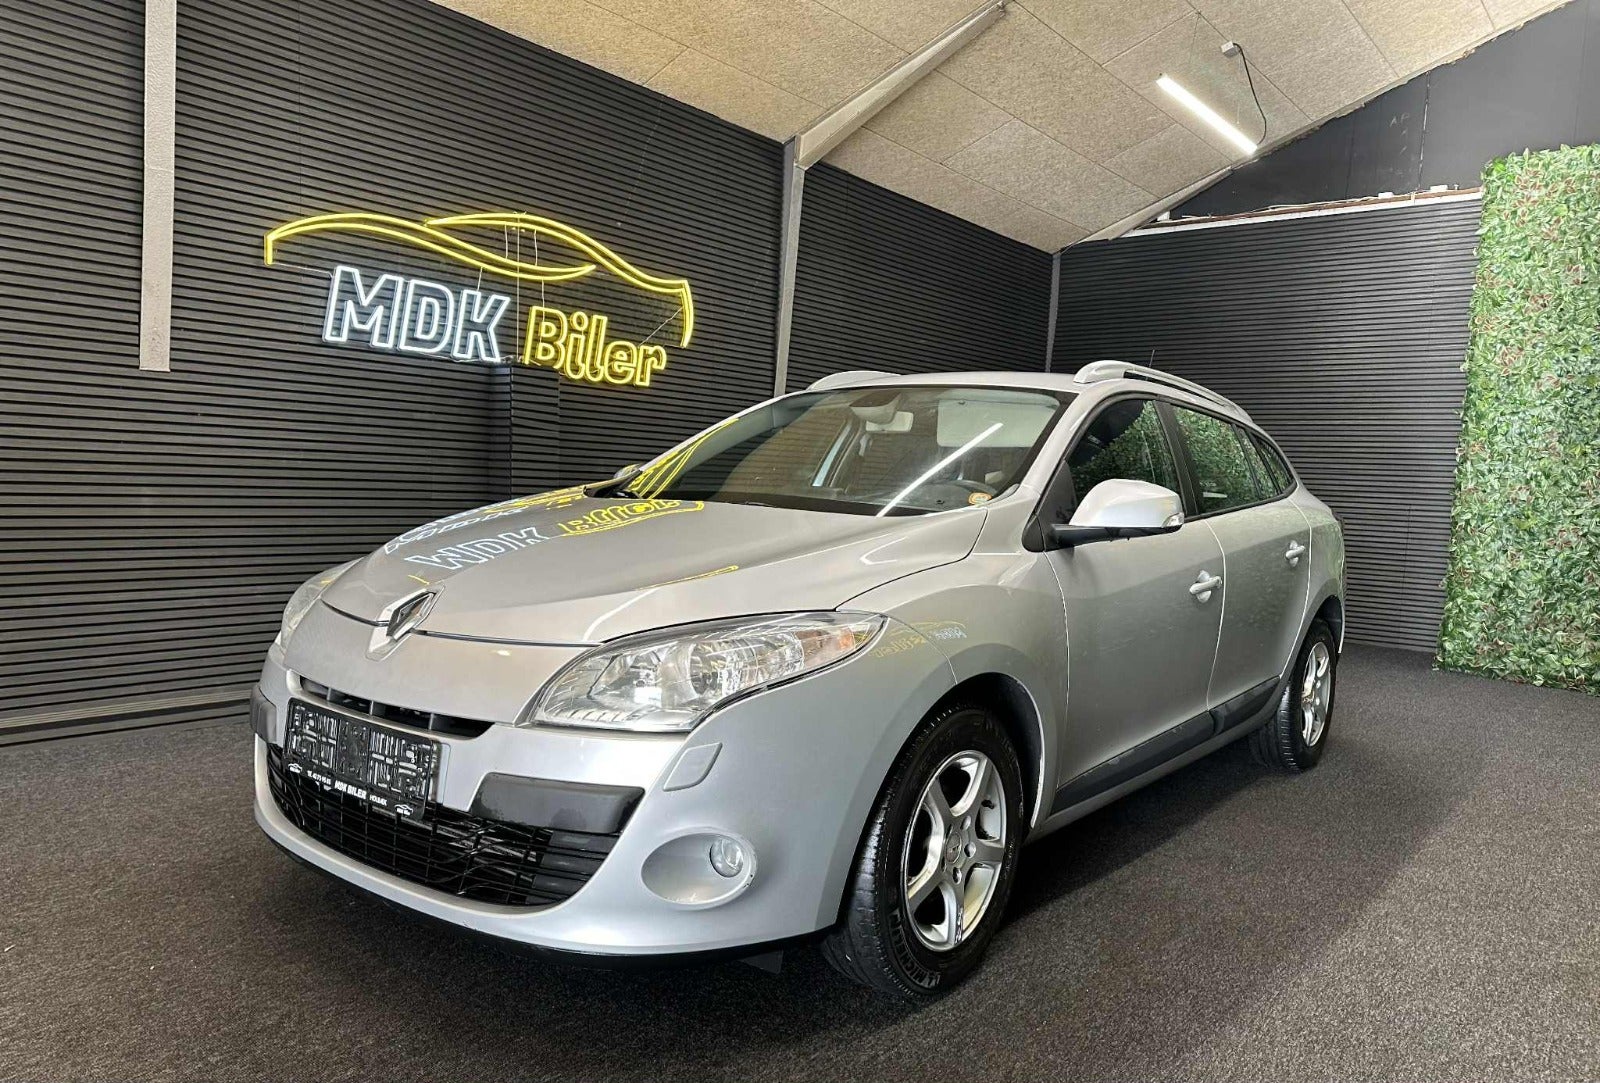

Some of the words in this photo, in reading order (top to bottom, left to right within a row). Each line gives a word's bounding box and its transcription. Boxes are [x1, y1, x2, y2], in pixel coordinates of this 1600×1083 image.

[324, 264, 511, 364] MDK
[523, 305, 667, 387] Biler
[347, 784, 367, 800] BILER
